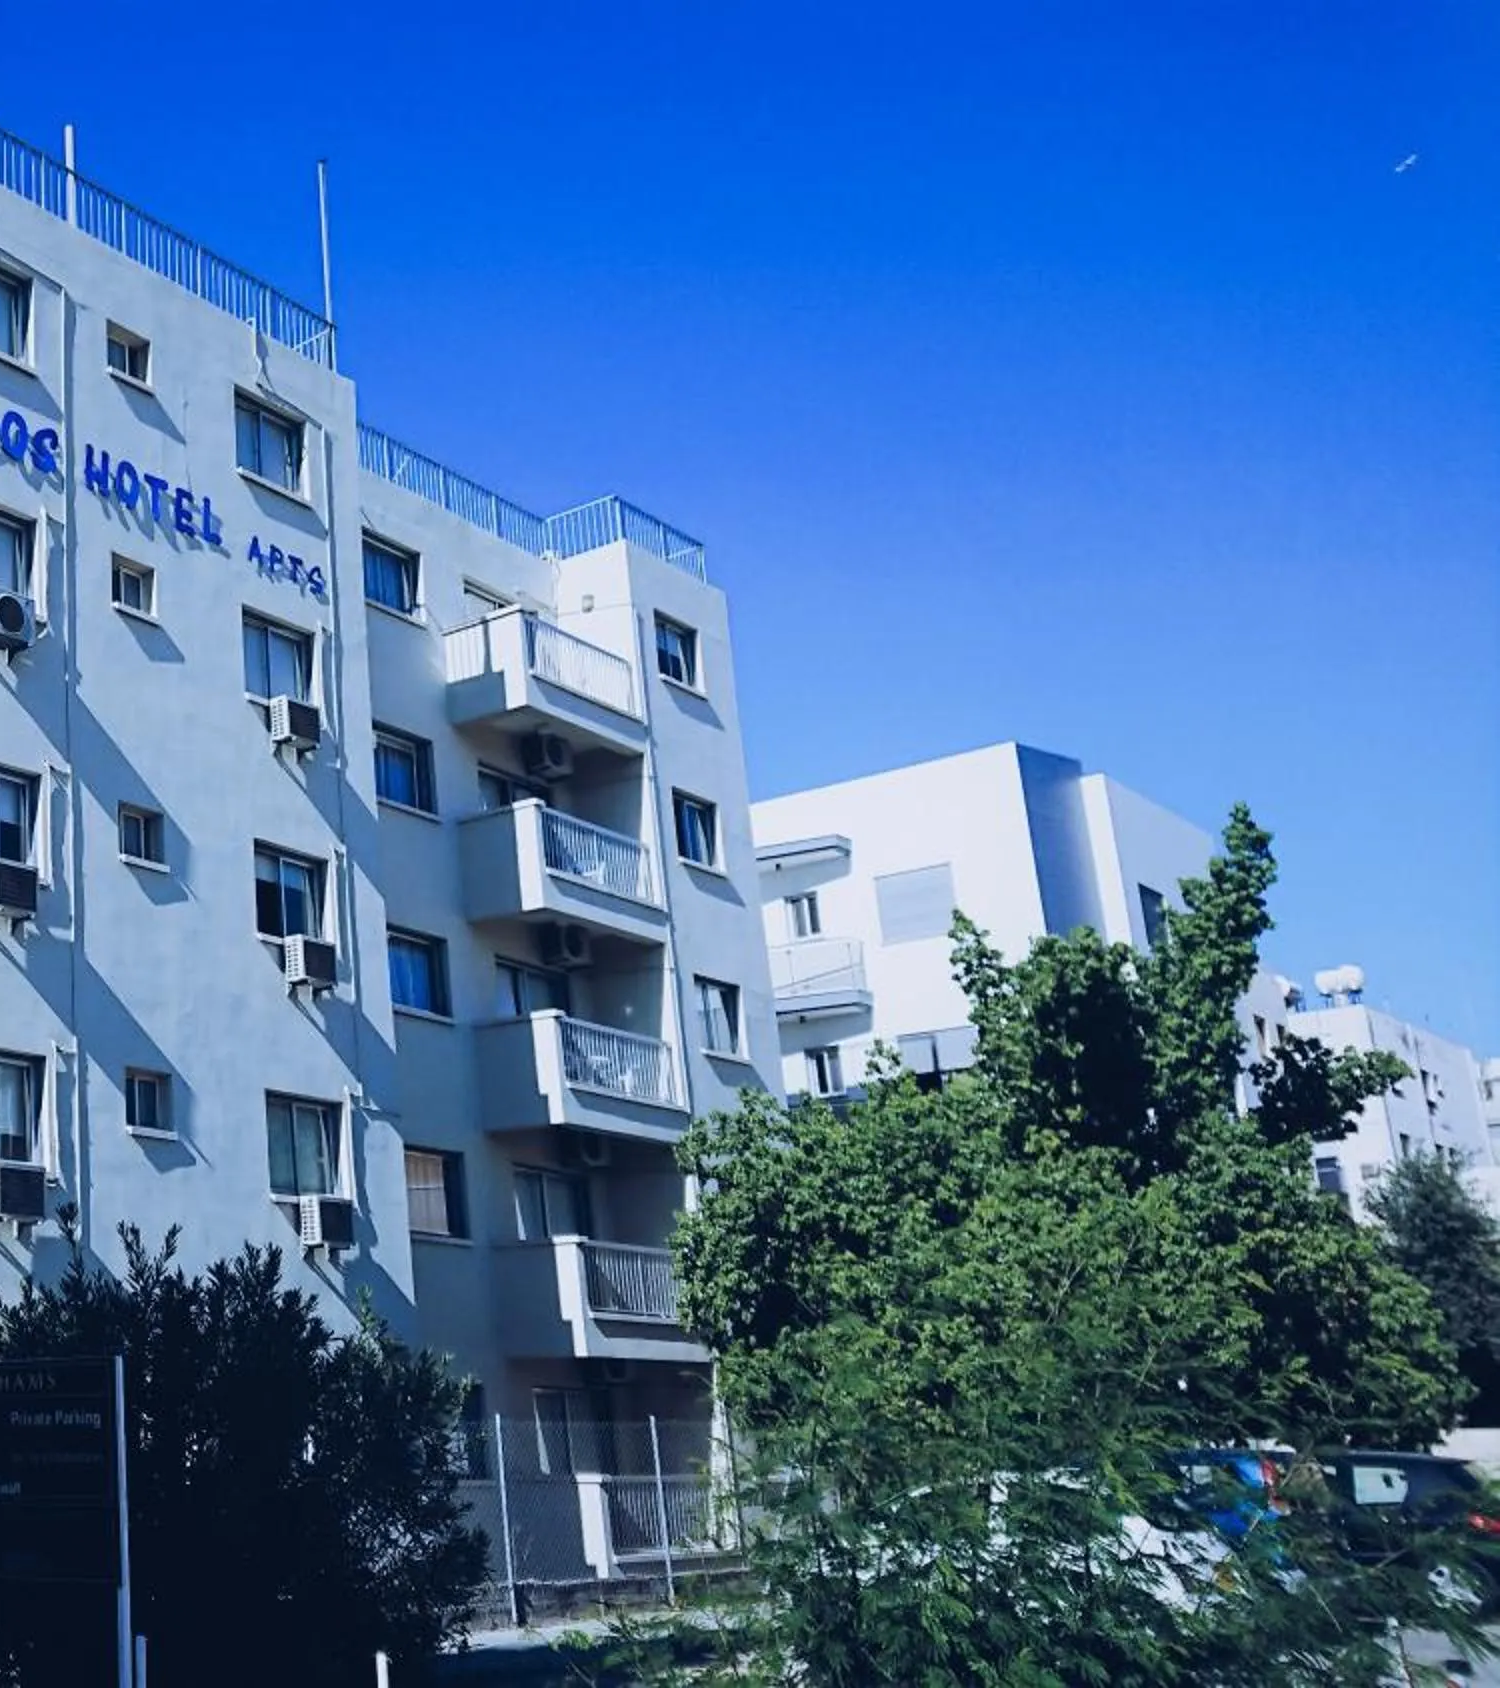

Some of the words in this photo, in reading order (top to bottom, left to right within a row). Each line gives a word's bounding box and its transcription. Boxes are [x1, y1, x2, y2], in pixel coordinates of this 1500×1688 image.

[84, 444, 223, 547] HOTEL
[248, 536, 327, 596] APTS
[55, 1409, 101, 1429] Parking
